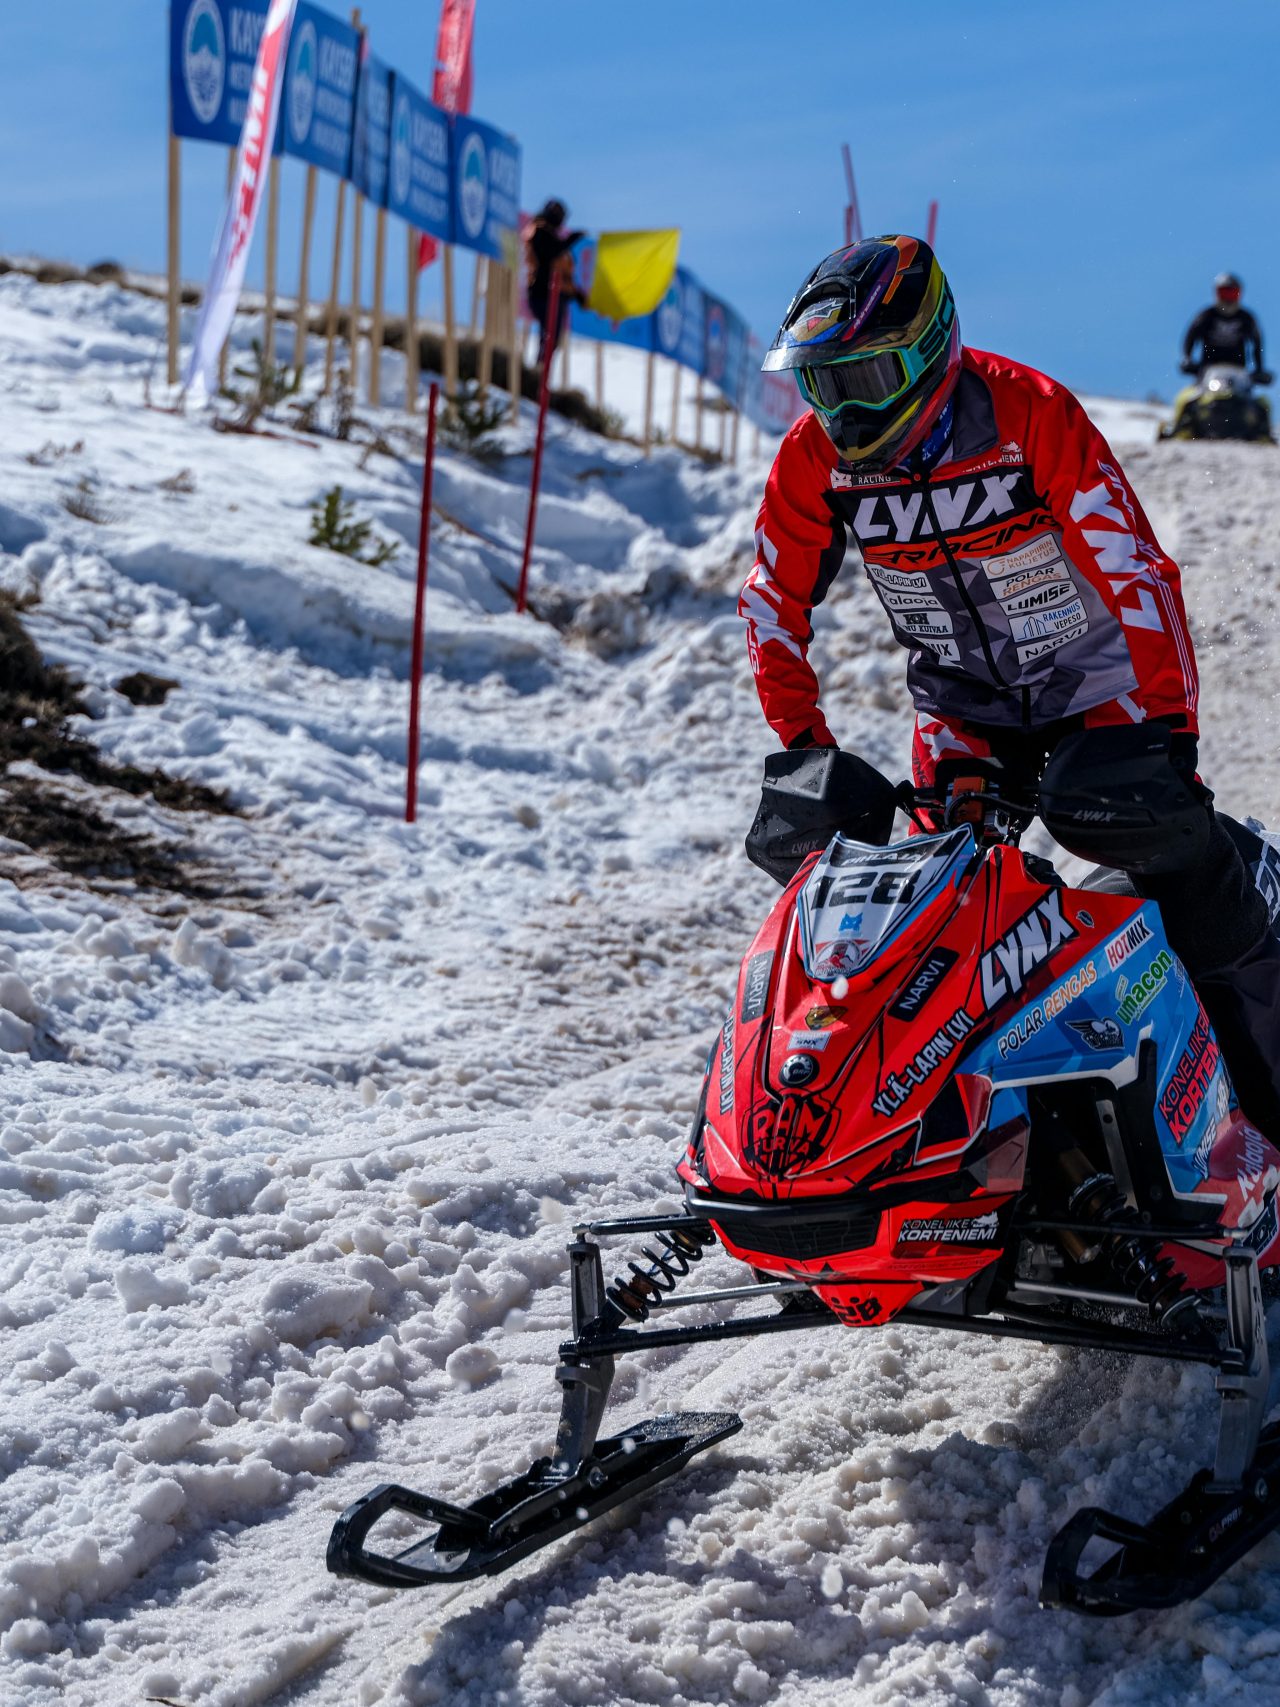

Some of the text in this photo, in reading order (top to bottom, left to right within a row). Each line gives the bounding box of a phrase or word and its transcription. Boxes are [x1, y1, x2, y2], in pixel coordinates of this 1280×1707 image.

[858, 475, 892, 484] RACING
[853, 473, 1024, 543] LYNX
[863, 512, 1062, 566] RACING
[1006, 540, 1053, 563] NAPAPIIRIN
[1008, 546, 1055, 569] KULJETUS
[1069, 482, 1165, 633] LYNX
[911, 576, 927, 588] LVI
[1002, 573, 1062, 597] RENGAS
[1006, 567, 1055, 587] POLAR
[1007, 583, 1071, 611] LUMISE
[1042, 601, 1081, 622] RAKENNUS
[1054, 612, 1081, 630] VEPESO
[1025, 628, 1082, 659] NARVI
[1072, 809, 1117, 822] LYNX
[792, 840, 818, 854] LYNX
[811, 869, 922, 911] 128
[981, 889, 1074, 1011] LYNX
[1106, 917, 1150, 967] HOTMIX
[748, 959, 767, 1010] NARVI
[900, 959, 945, 1010] NARVI
[998, 1008, 1045, 1060] POLAR
[1043, 960, 1098, 1021] RENGAS
[873, 1007, 975, 1117] YLÄ-LAPIN LVI
[1168, 1040, 1221, 1145] KORTEN
[753, 1097, 827, 1142] RAM
[1236, 1124, 1270, 1201] Kalaoja
[898, 1228, 997, 1242] KORTENIEMI
[902, 1219, 968, 1229] KONELIIKE
